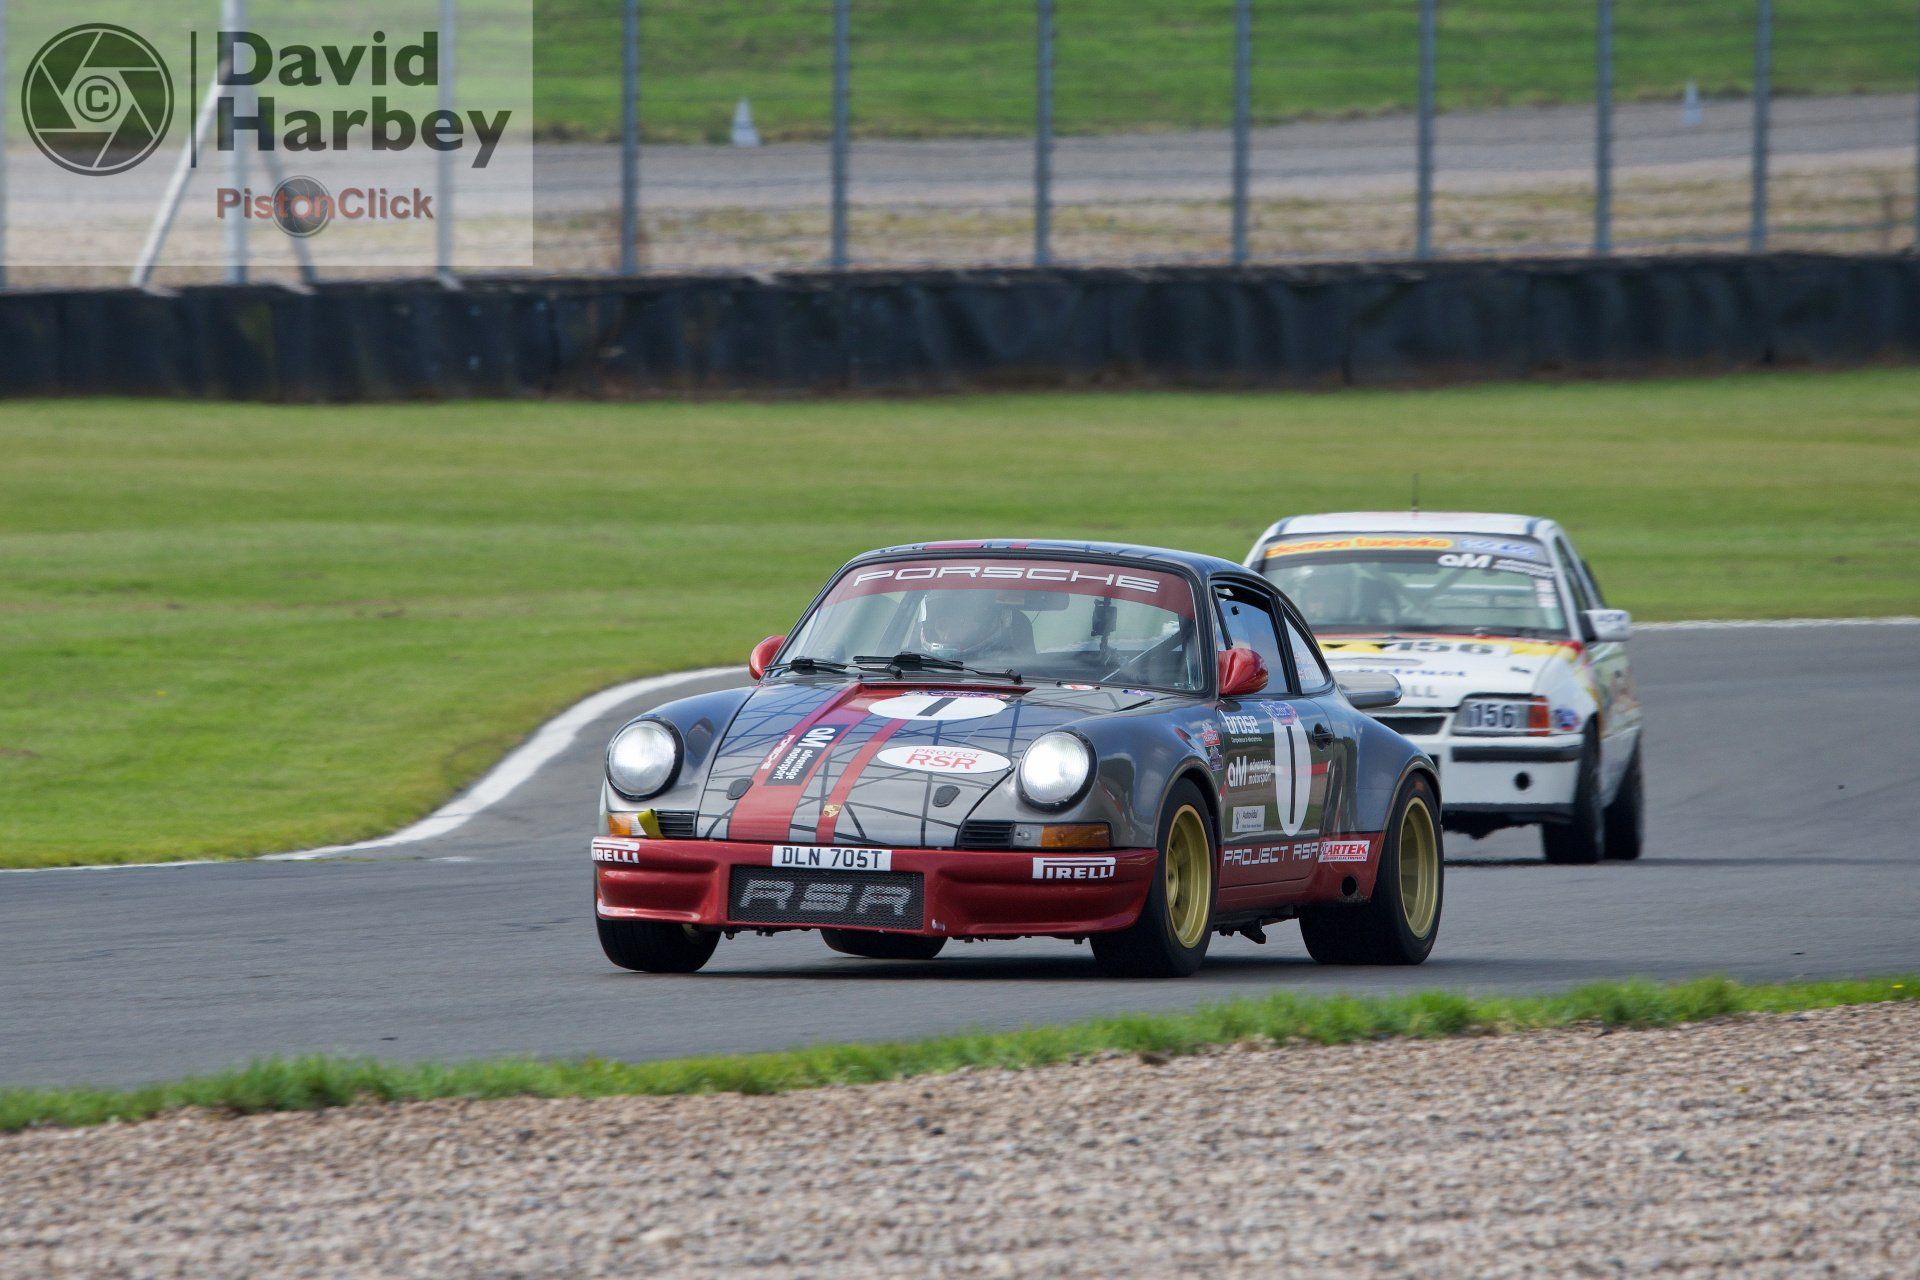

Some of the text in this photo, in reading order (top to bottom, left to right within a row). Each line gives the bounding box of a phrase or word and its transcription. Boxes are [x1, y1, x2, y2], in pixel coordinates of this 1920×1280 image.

[853, 566, 1160, 593] PORSCHE
[1398, 641, 1494, 654] 156
[916, 697, 959, 717] 1
[1471, 703, 1514, 729] 156
[1219, 709, 1260, 735] brose
[906, 753, 977, 770] RSR
[914, 748, 982, 758] PROJECT
[1286, 726, 1296, 825] 1
[591, 837, 640, 864] PIRELLI
[781, 847, 883, 869] DLN 705T
[1223, 841, 1320, 867] PROJECT RSR
[1032, 857, 1117, 879] PIRELLI
[739, 879, 913, 916] RSR
